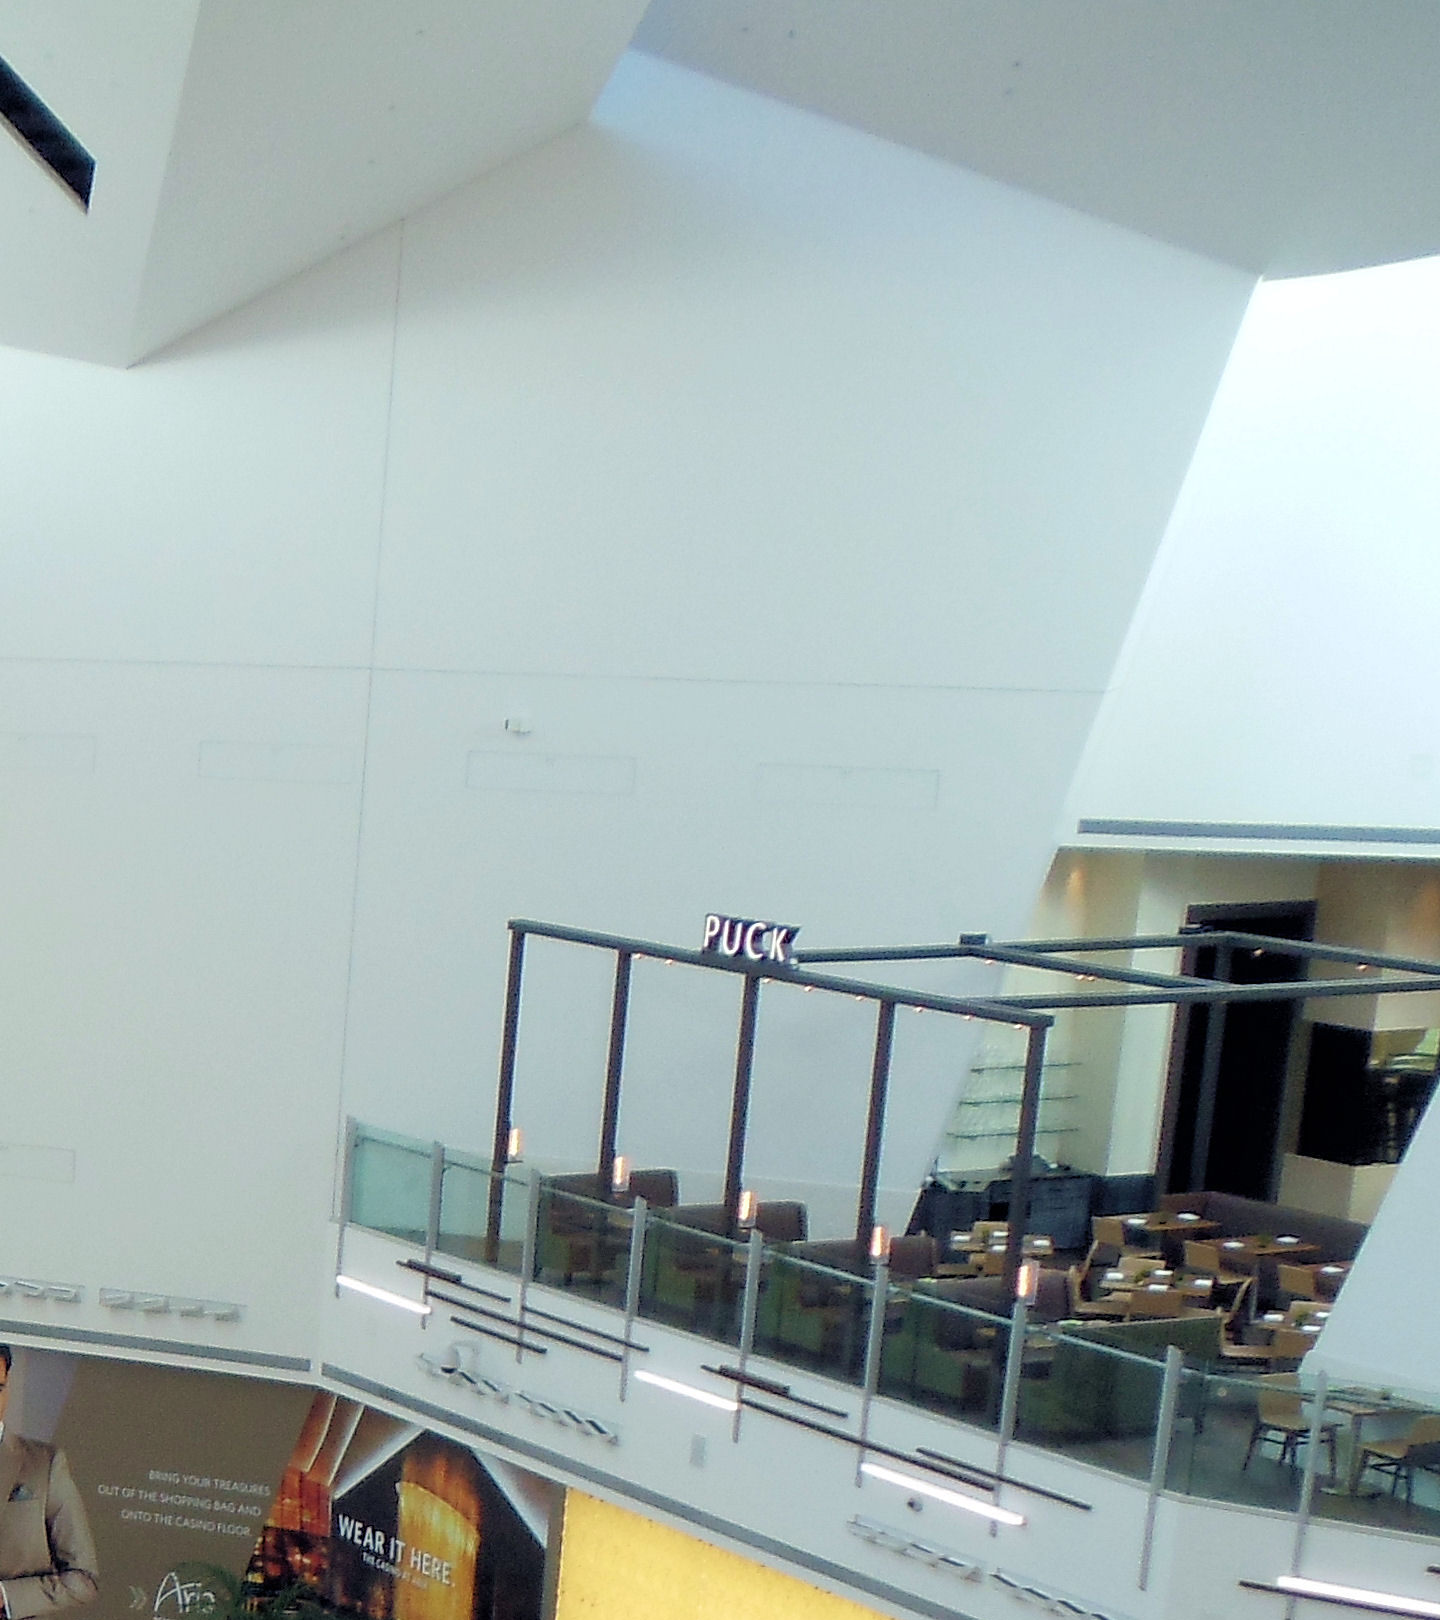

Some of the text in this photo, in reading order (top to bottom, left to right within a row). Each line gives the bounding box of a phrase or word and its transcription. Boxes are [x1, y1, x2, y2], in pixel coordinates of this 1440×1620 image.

[148, 1469, 271, 1497] BRING YOUR TREASURES
[97, 1484, 262, 1517] OUT OF THE SHOPPING BAG AND
[121, 1508, 153, 1523] ONTO
[154, 1513, 173, 1526] THE
[175, 1516, 216, 1532] CASINO
[338, 1513, 456, 1588] WEAR IT HERE.
